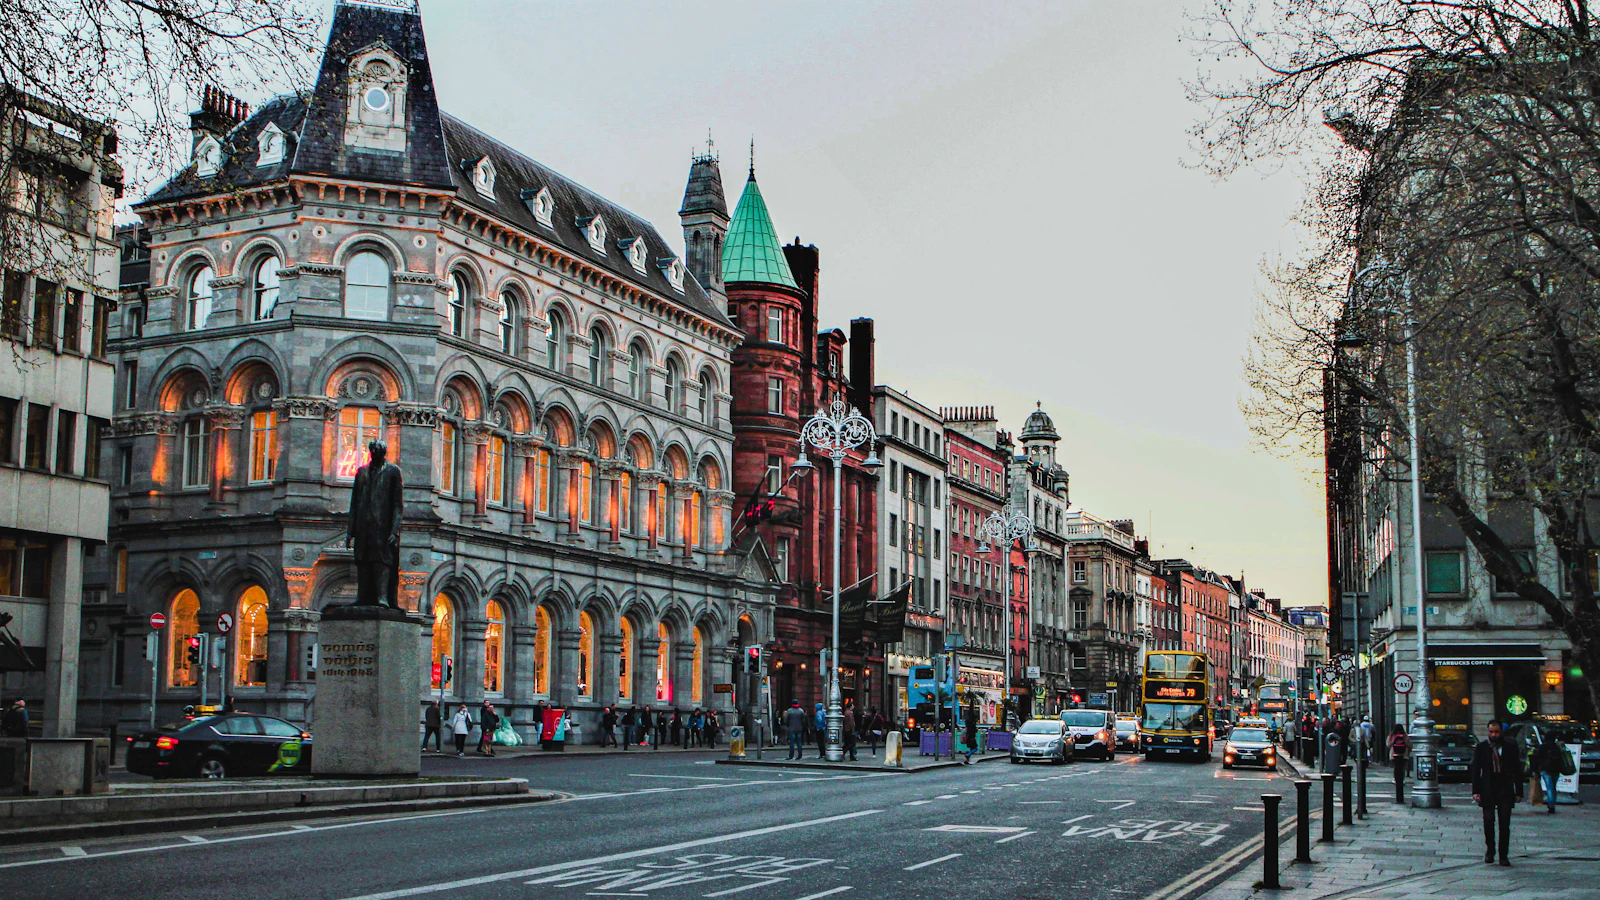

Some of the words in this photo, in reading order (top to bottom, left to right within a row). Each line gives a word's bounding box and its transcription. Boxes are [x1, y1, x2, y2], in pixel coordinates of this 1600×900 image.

[1186, 688, 1196, 697] 79
[1107, 818, 1230, 834] BUS
[636, 853, 835, 875] BUS
